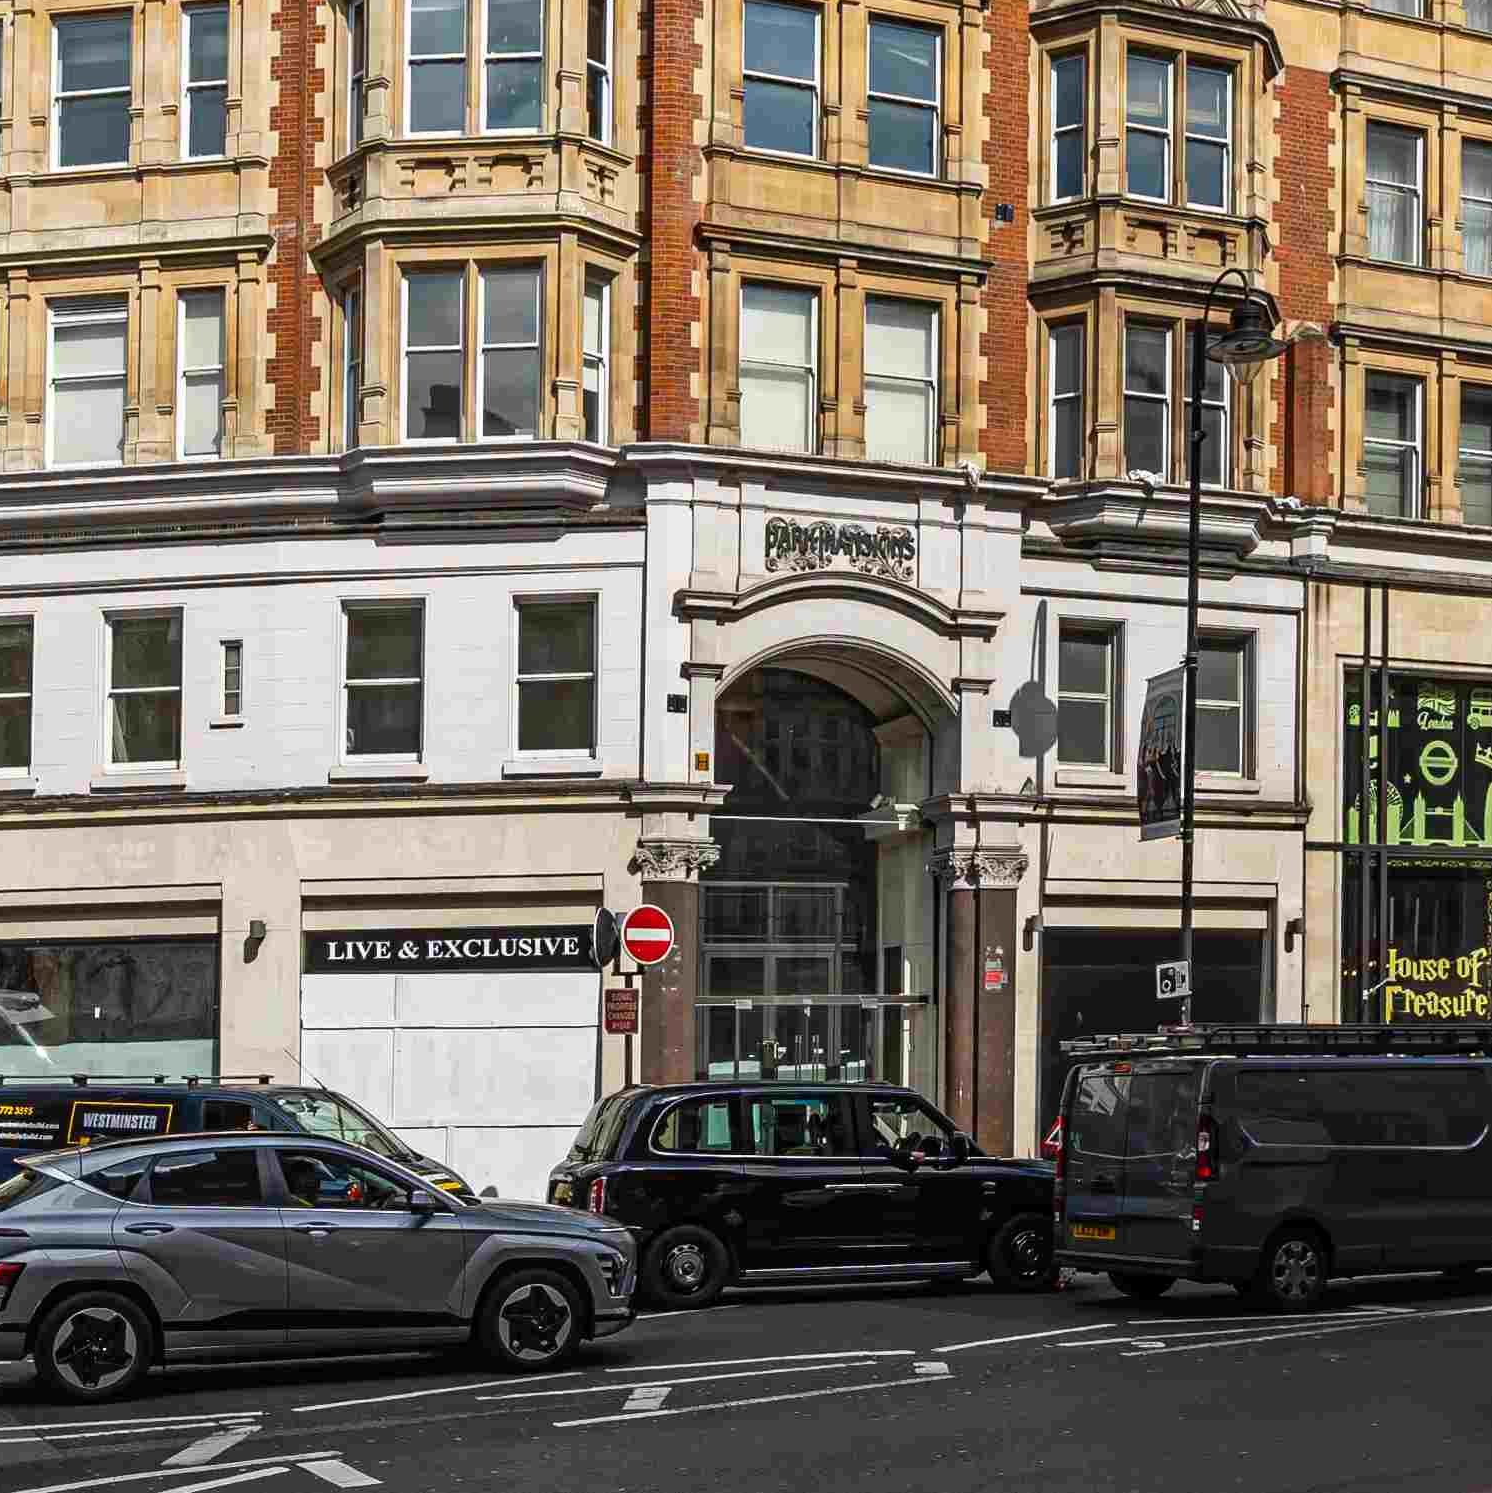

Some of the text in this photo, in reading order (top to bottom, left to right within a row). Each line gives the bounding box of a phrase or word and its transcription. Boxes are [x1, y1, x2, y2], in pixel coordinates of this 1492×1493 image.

[328, 937, 580, 960] LIVE & EXCLUSIVE
[1456, 947, 1488, 988] of
[83, 1112, 158, 1130] WESTMINSTER
